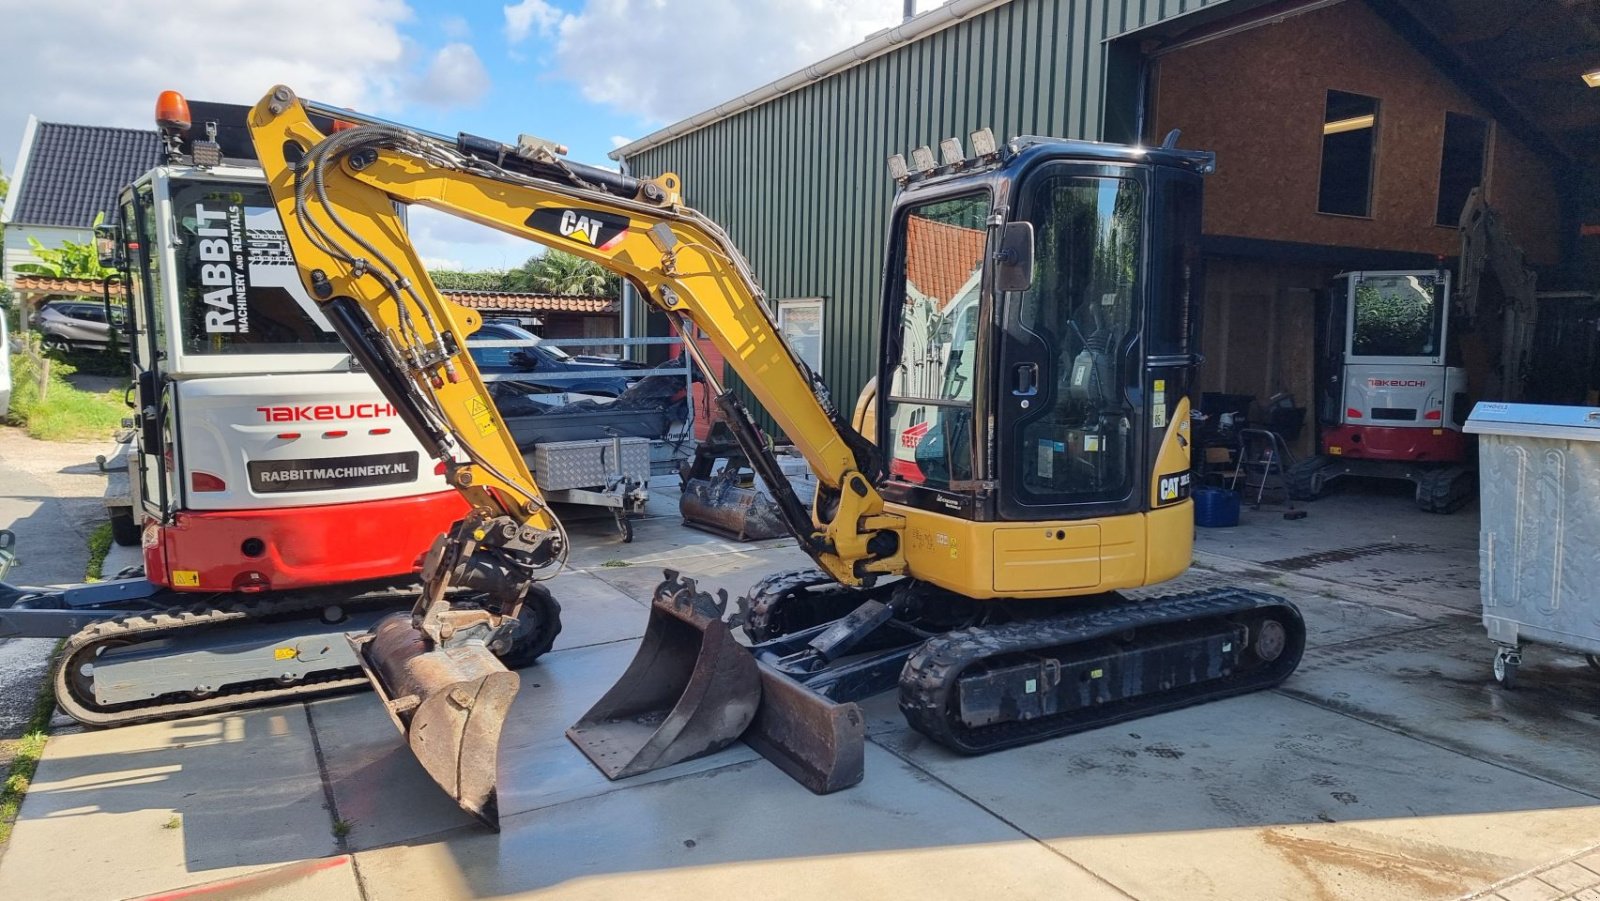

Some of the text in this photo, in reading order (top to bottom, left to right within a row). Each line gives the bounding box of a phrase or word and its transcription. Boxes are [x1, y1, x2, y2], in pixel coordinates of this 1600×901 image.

[560, 210, 603, 246] CAT
[196, 203, 236, 333] RABBIT
[229, 205, 249, 333] MACHINERY AND RENTALS
[261, 463, 410, 482] RABBITMACHINERY.NL
[1161, 476, 1179, 500] CAT
